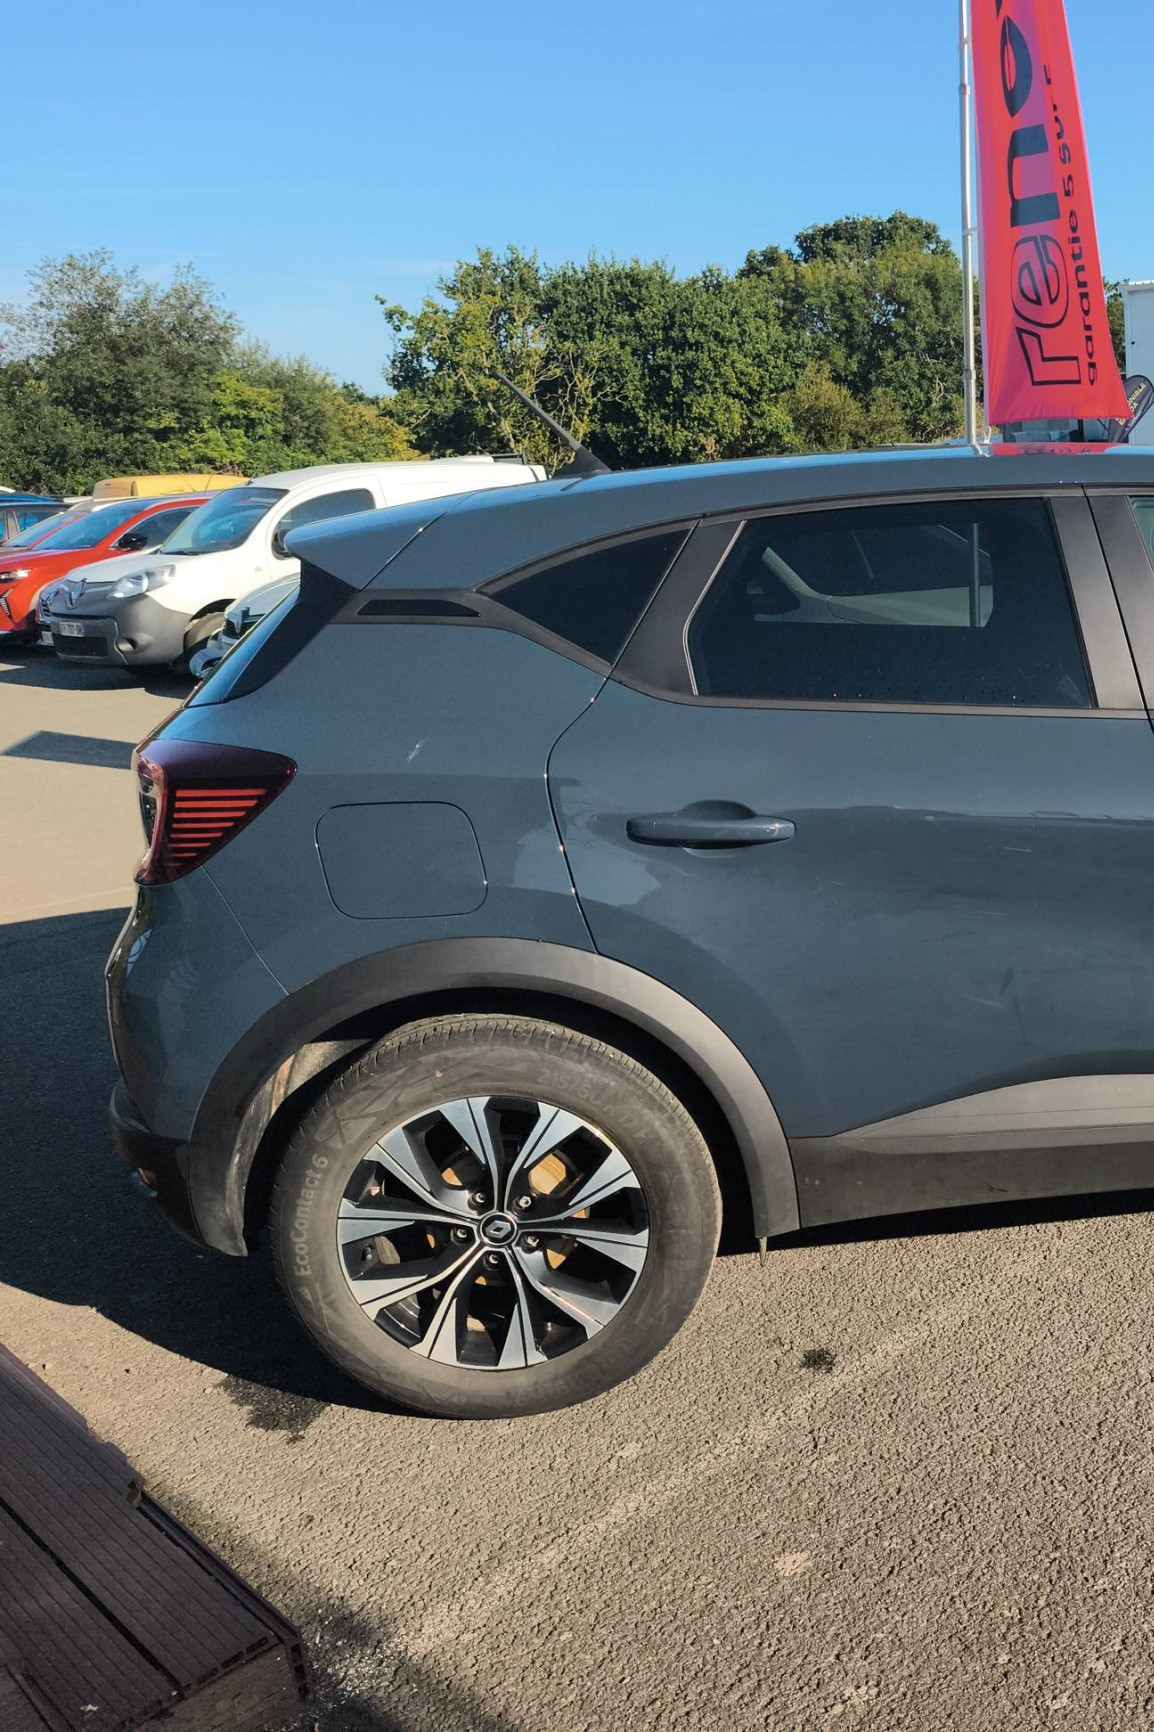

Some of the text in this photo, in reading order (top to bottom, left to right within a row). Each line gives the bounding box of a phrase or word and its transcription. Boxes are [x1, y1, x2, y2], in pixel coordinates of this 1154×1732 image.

[995, 0, 1081, 386] rene
[1063, 174, 1074, 197] 5
[1066, 209, 1097, 386] garantie
[290, 1153, 329, 1278] EcoContact 6
